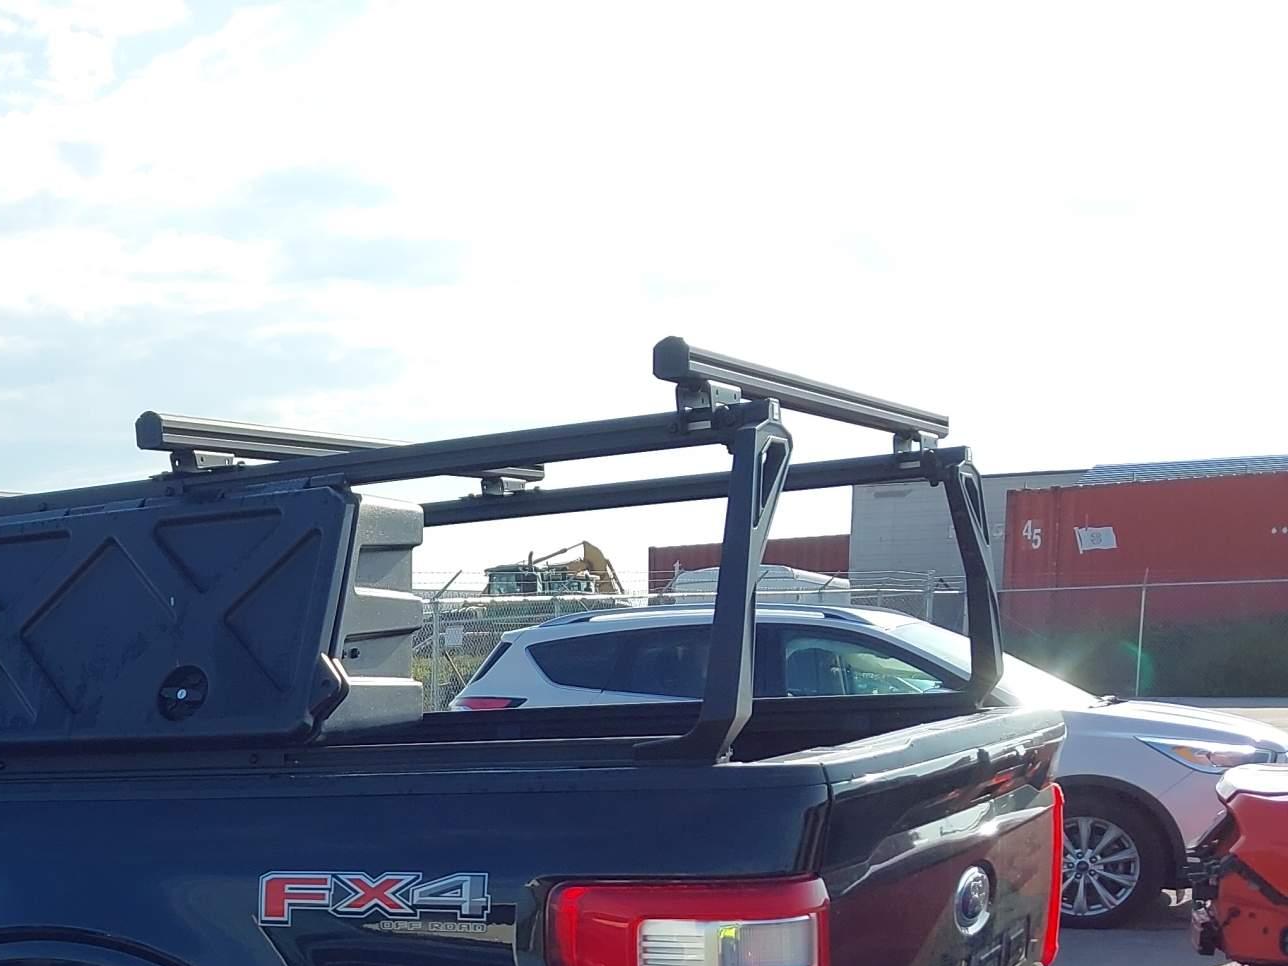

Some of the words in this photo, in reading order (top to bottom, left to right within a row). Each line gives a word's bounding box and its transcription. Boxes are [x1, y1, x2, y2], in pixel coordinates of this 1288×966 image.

[259, 872, 490, 926] FX4
[379, 920, 423, 931] OFF
[427, 921, 487, 933] ROAD
